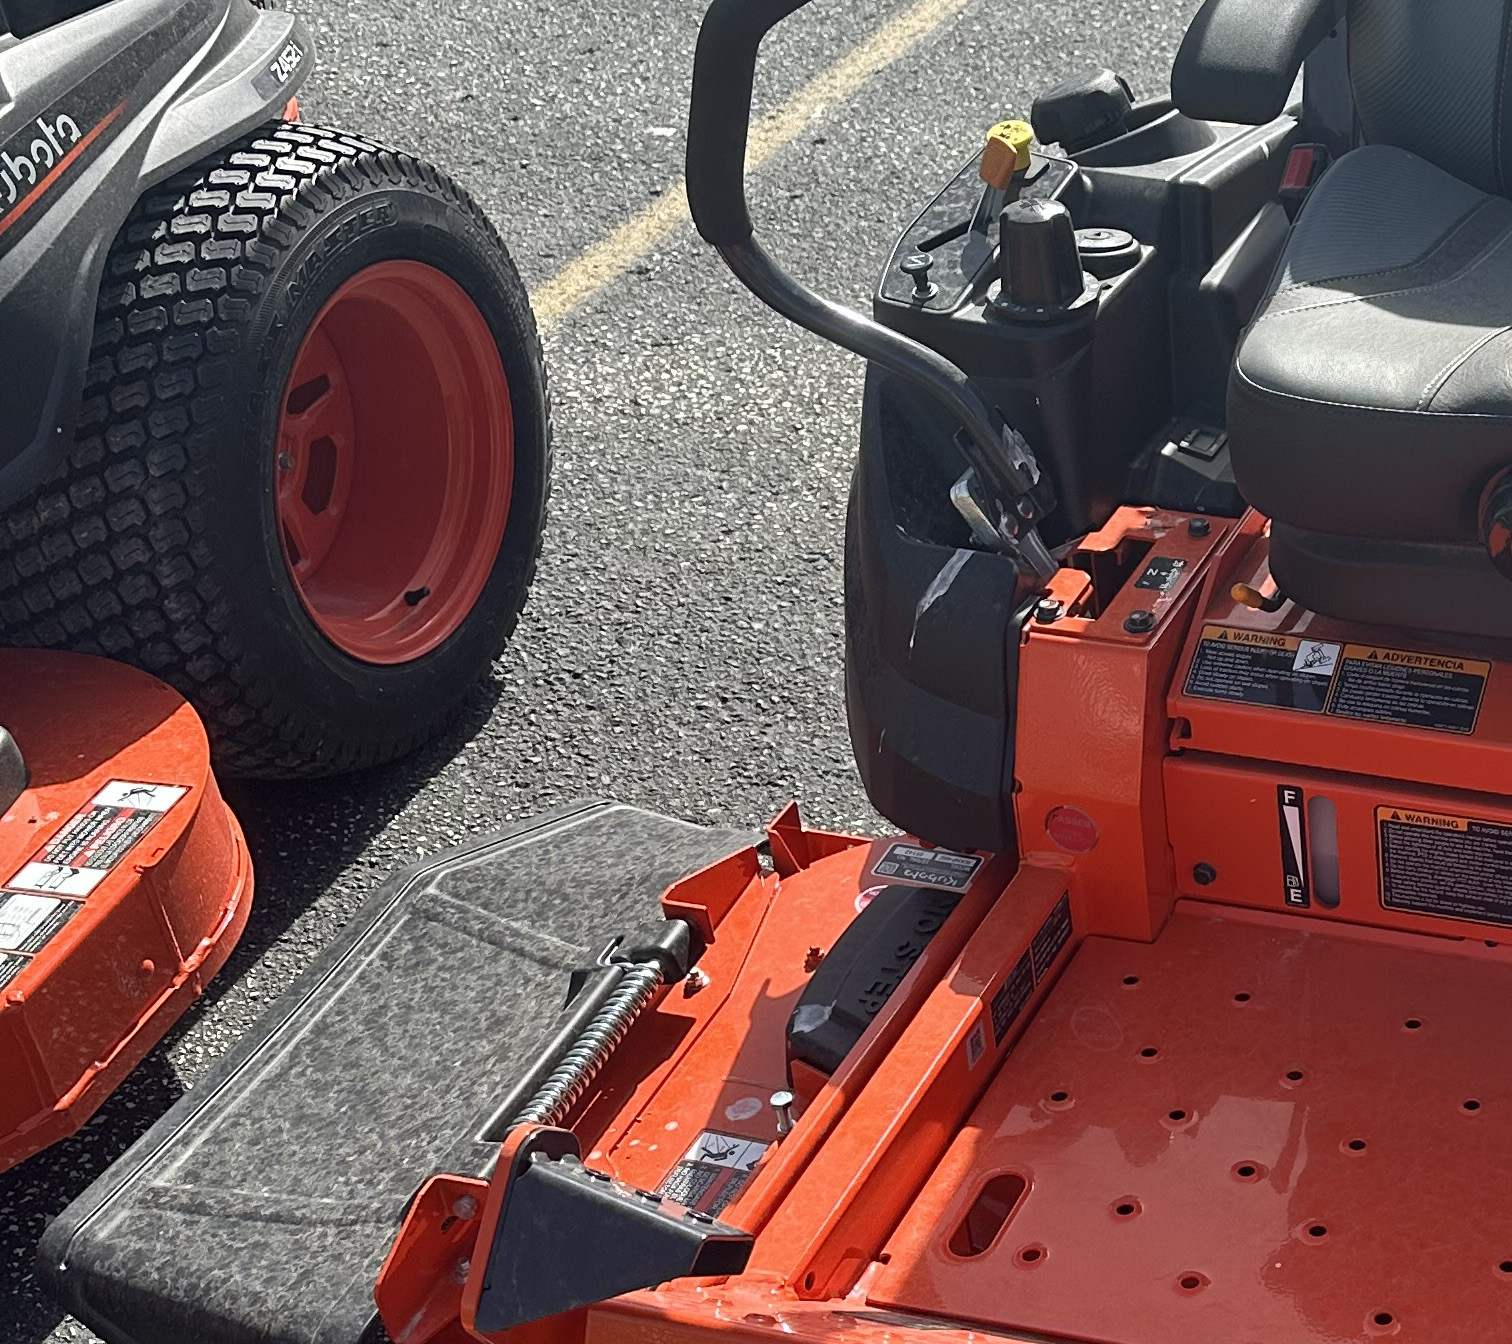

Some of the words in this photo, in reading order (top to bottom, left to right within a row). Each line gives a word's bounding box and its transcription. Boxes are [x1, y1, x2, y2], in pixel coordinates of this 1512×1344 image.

[0, 114, 82, 213] ubota
[1233, 631, 1286, 647] WARNING
[1382, 651, 1464, 671] ADVERTENCIA
[1283, 789, 1296, 804] F
[1404, 813, 1459, 829] WARNING
[903, 869, 958, 887] Kubota
[1290, 888, 1303, 903] E
